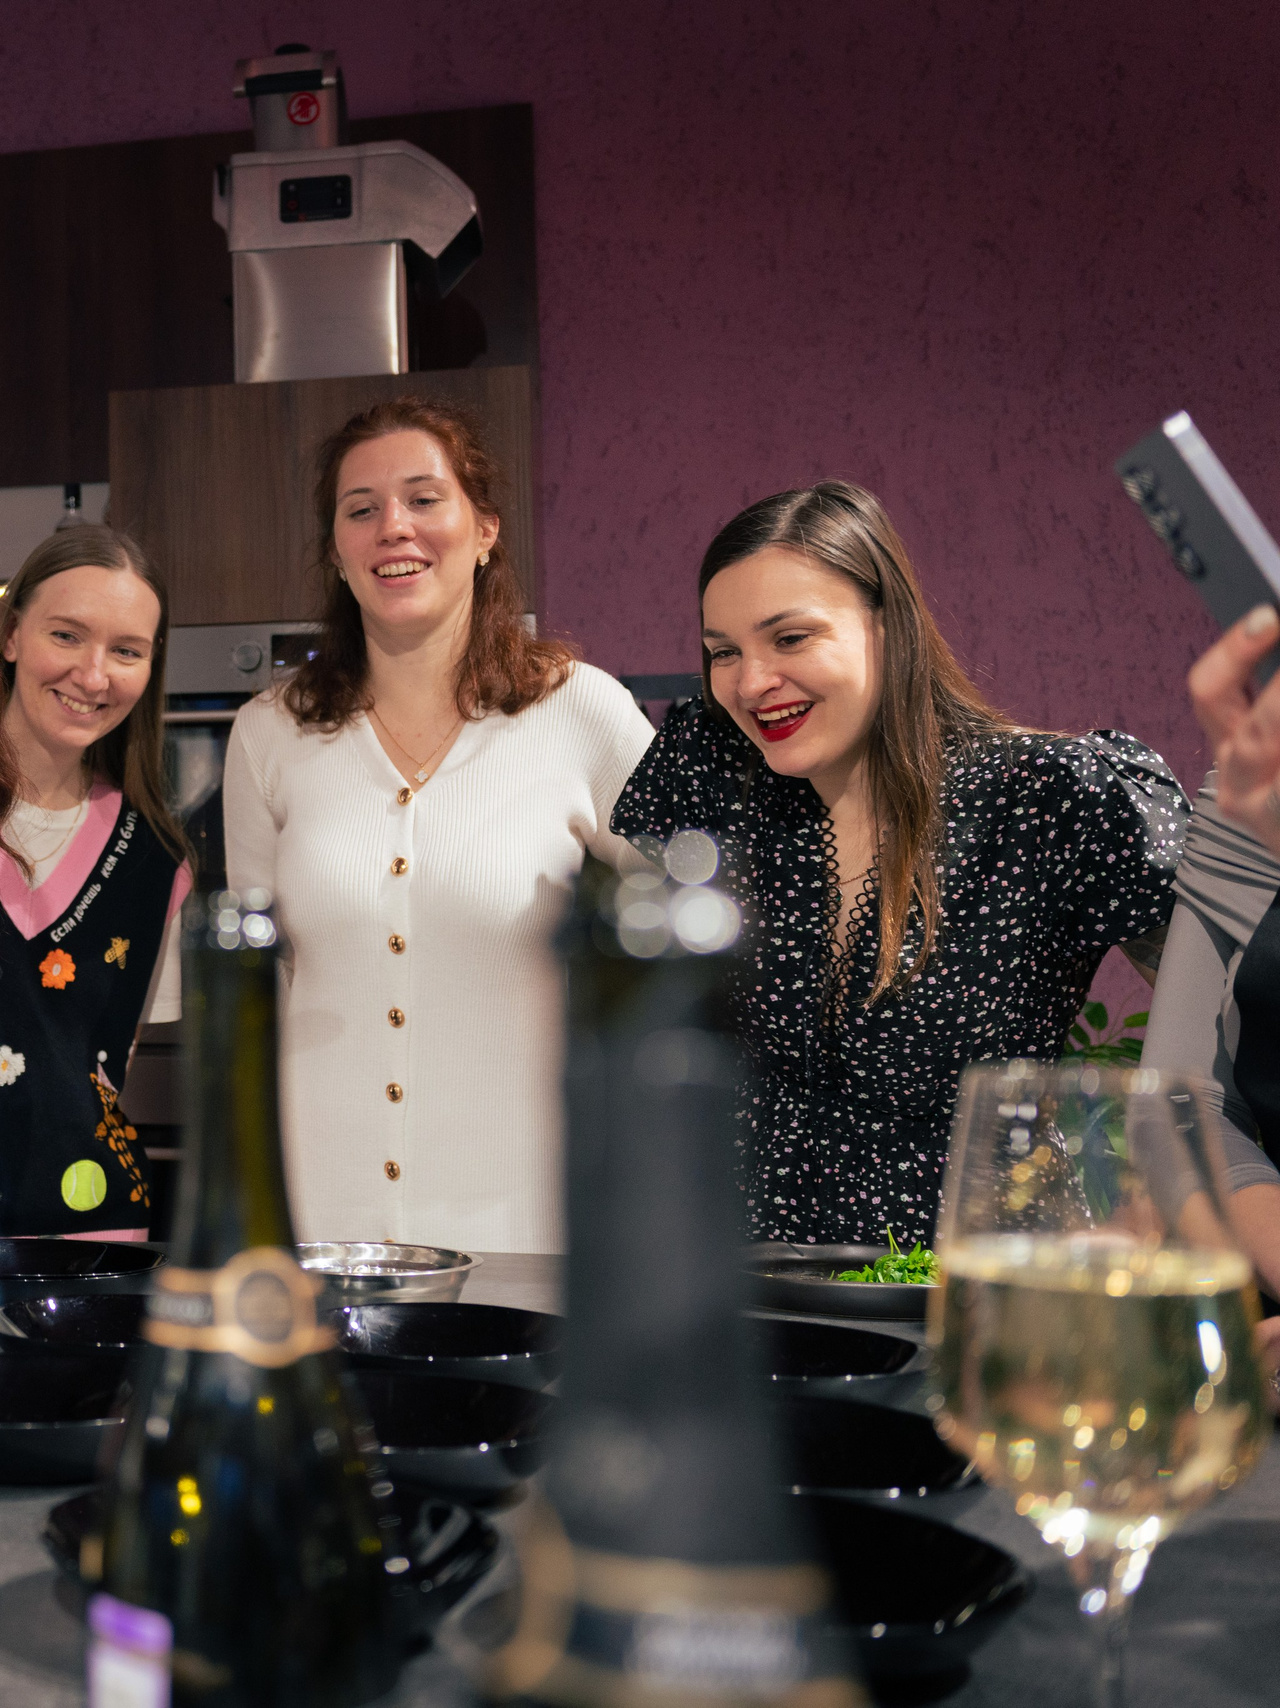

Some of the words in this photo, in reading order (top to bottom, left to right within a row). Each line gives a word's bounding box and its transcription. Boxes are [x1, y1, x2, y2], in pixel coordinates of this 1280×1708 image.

[50, 917, 77, 943] Если
[73, 883, 102, 923] хочешь
[100, 854, 119, 879] кем
